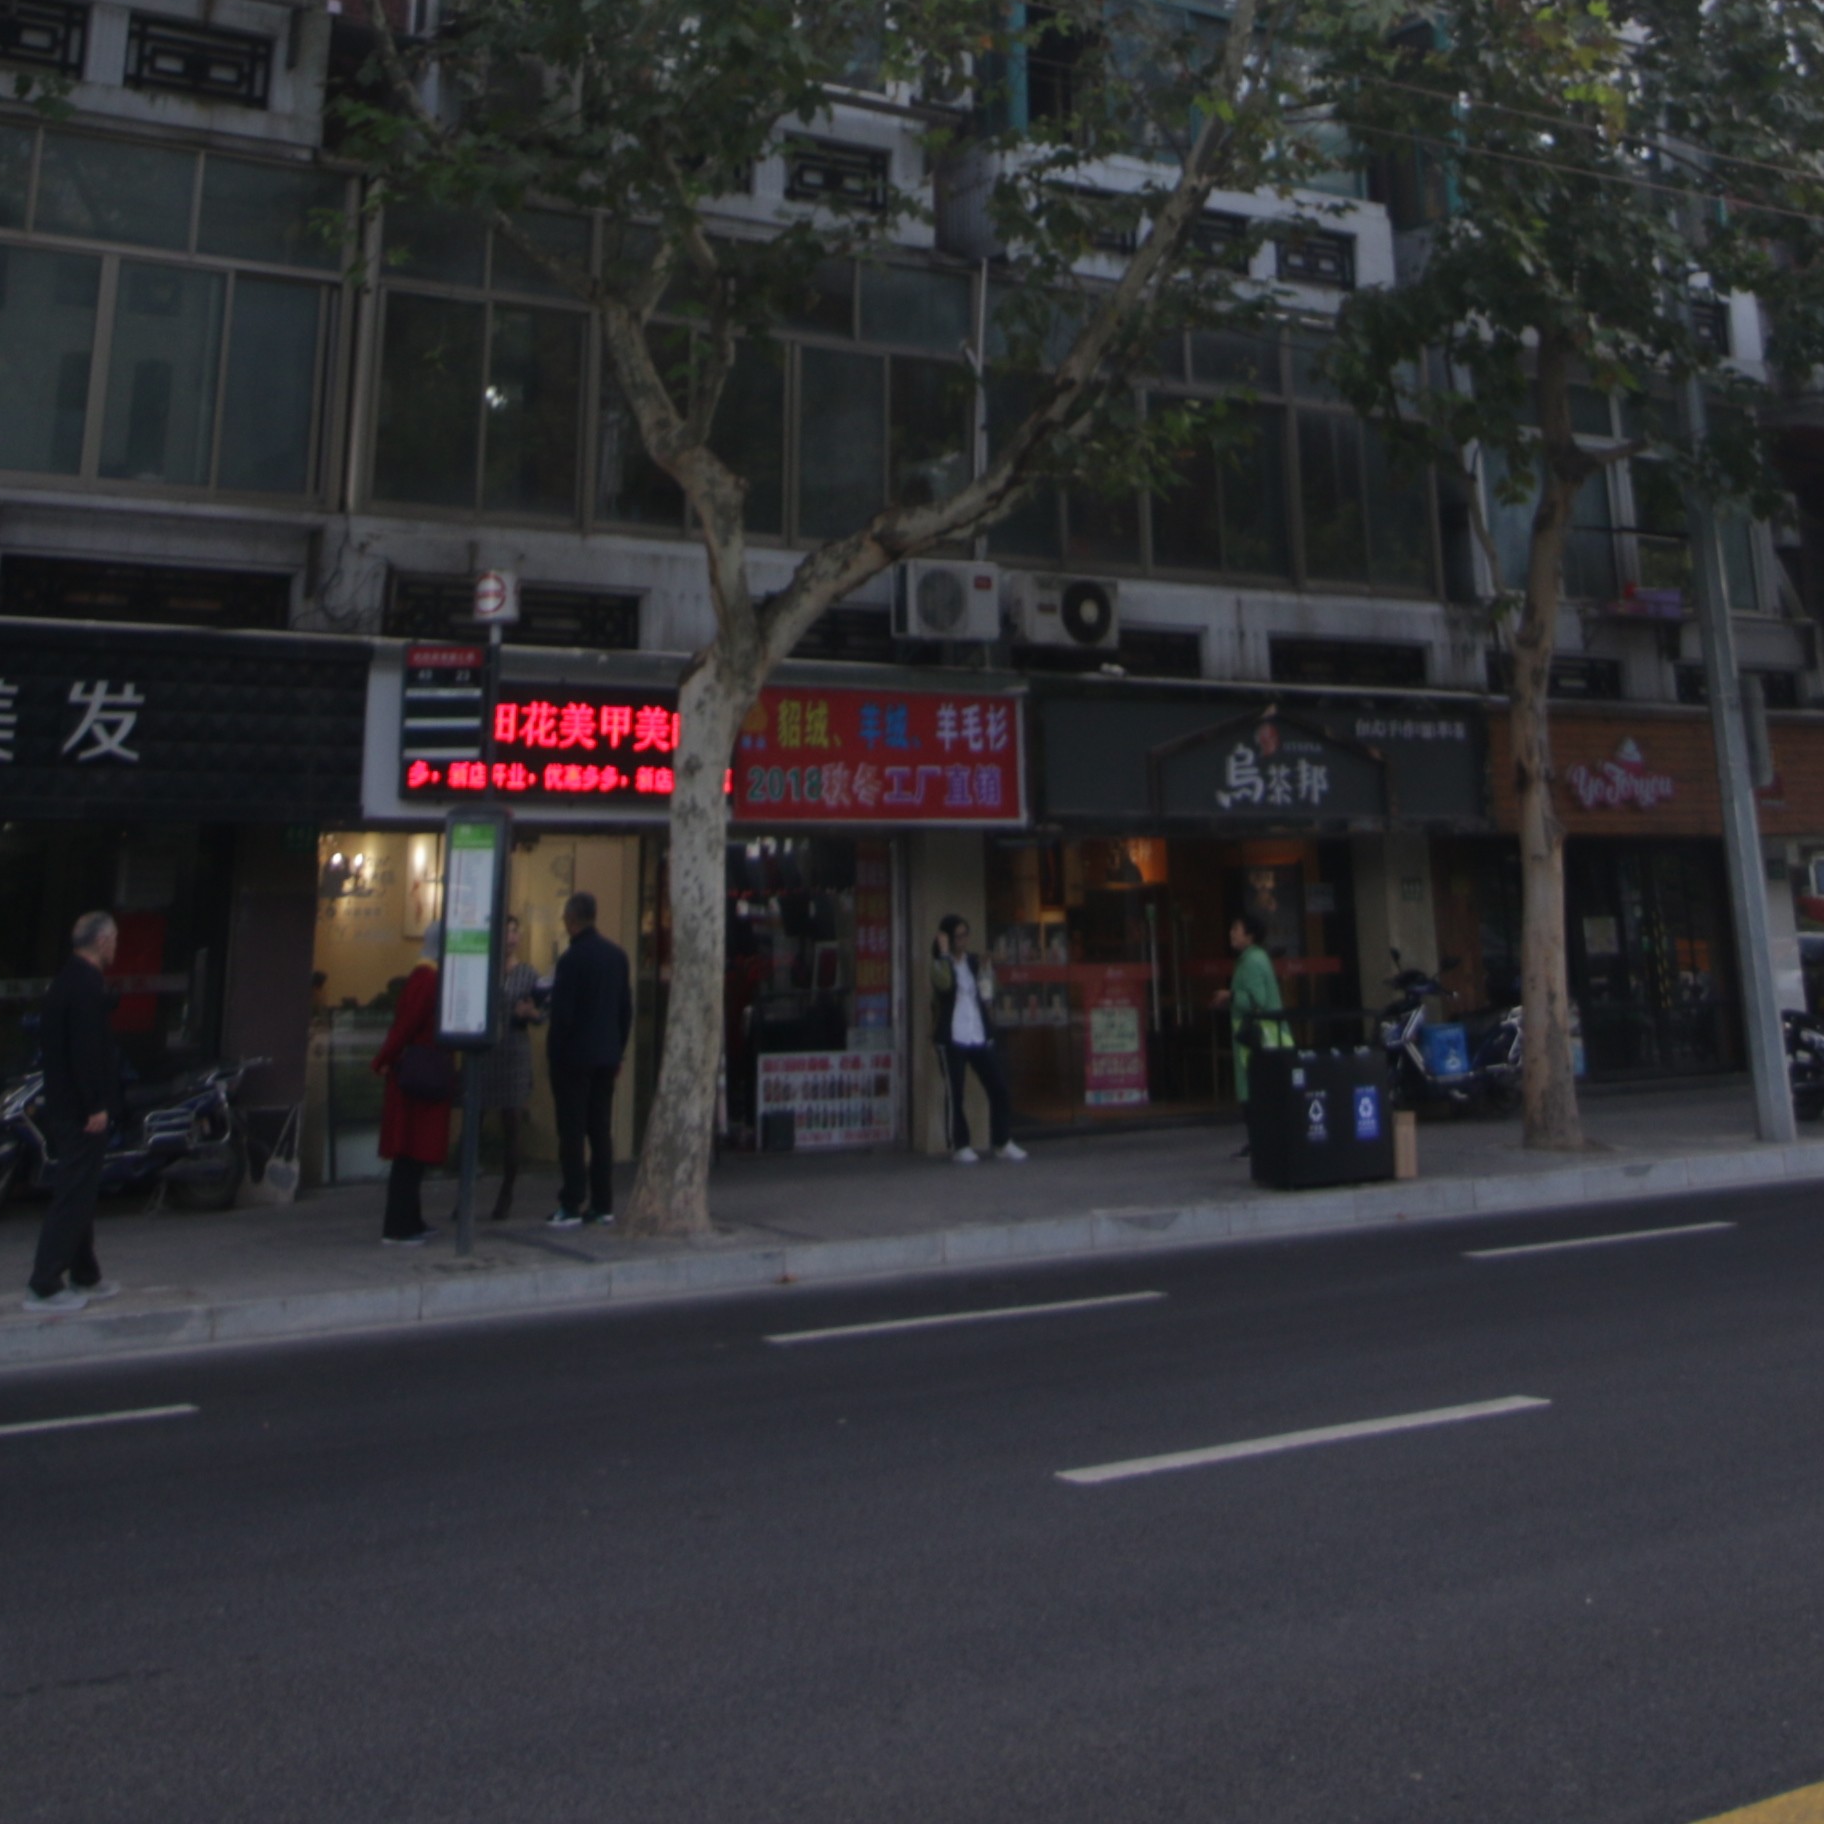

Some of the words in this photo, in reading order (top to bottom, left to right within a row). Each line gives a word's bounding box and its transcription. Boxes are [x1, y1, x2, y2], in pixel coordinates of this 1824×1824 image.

[494, 701, 681, 752] 花美甲美
[747, 762, 1002, 809] 2018秋冬工厂直销
